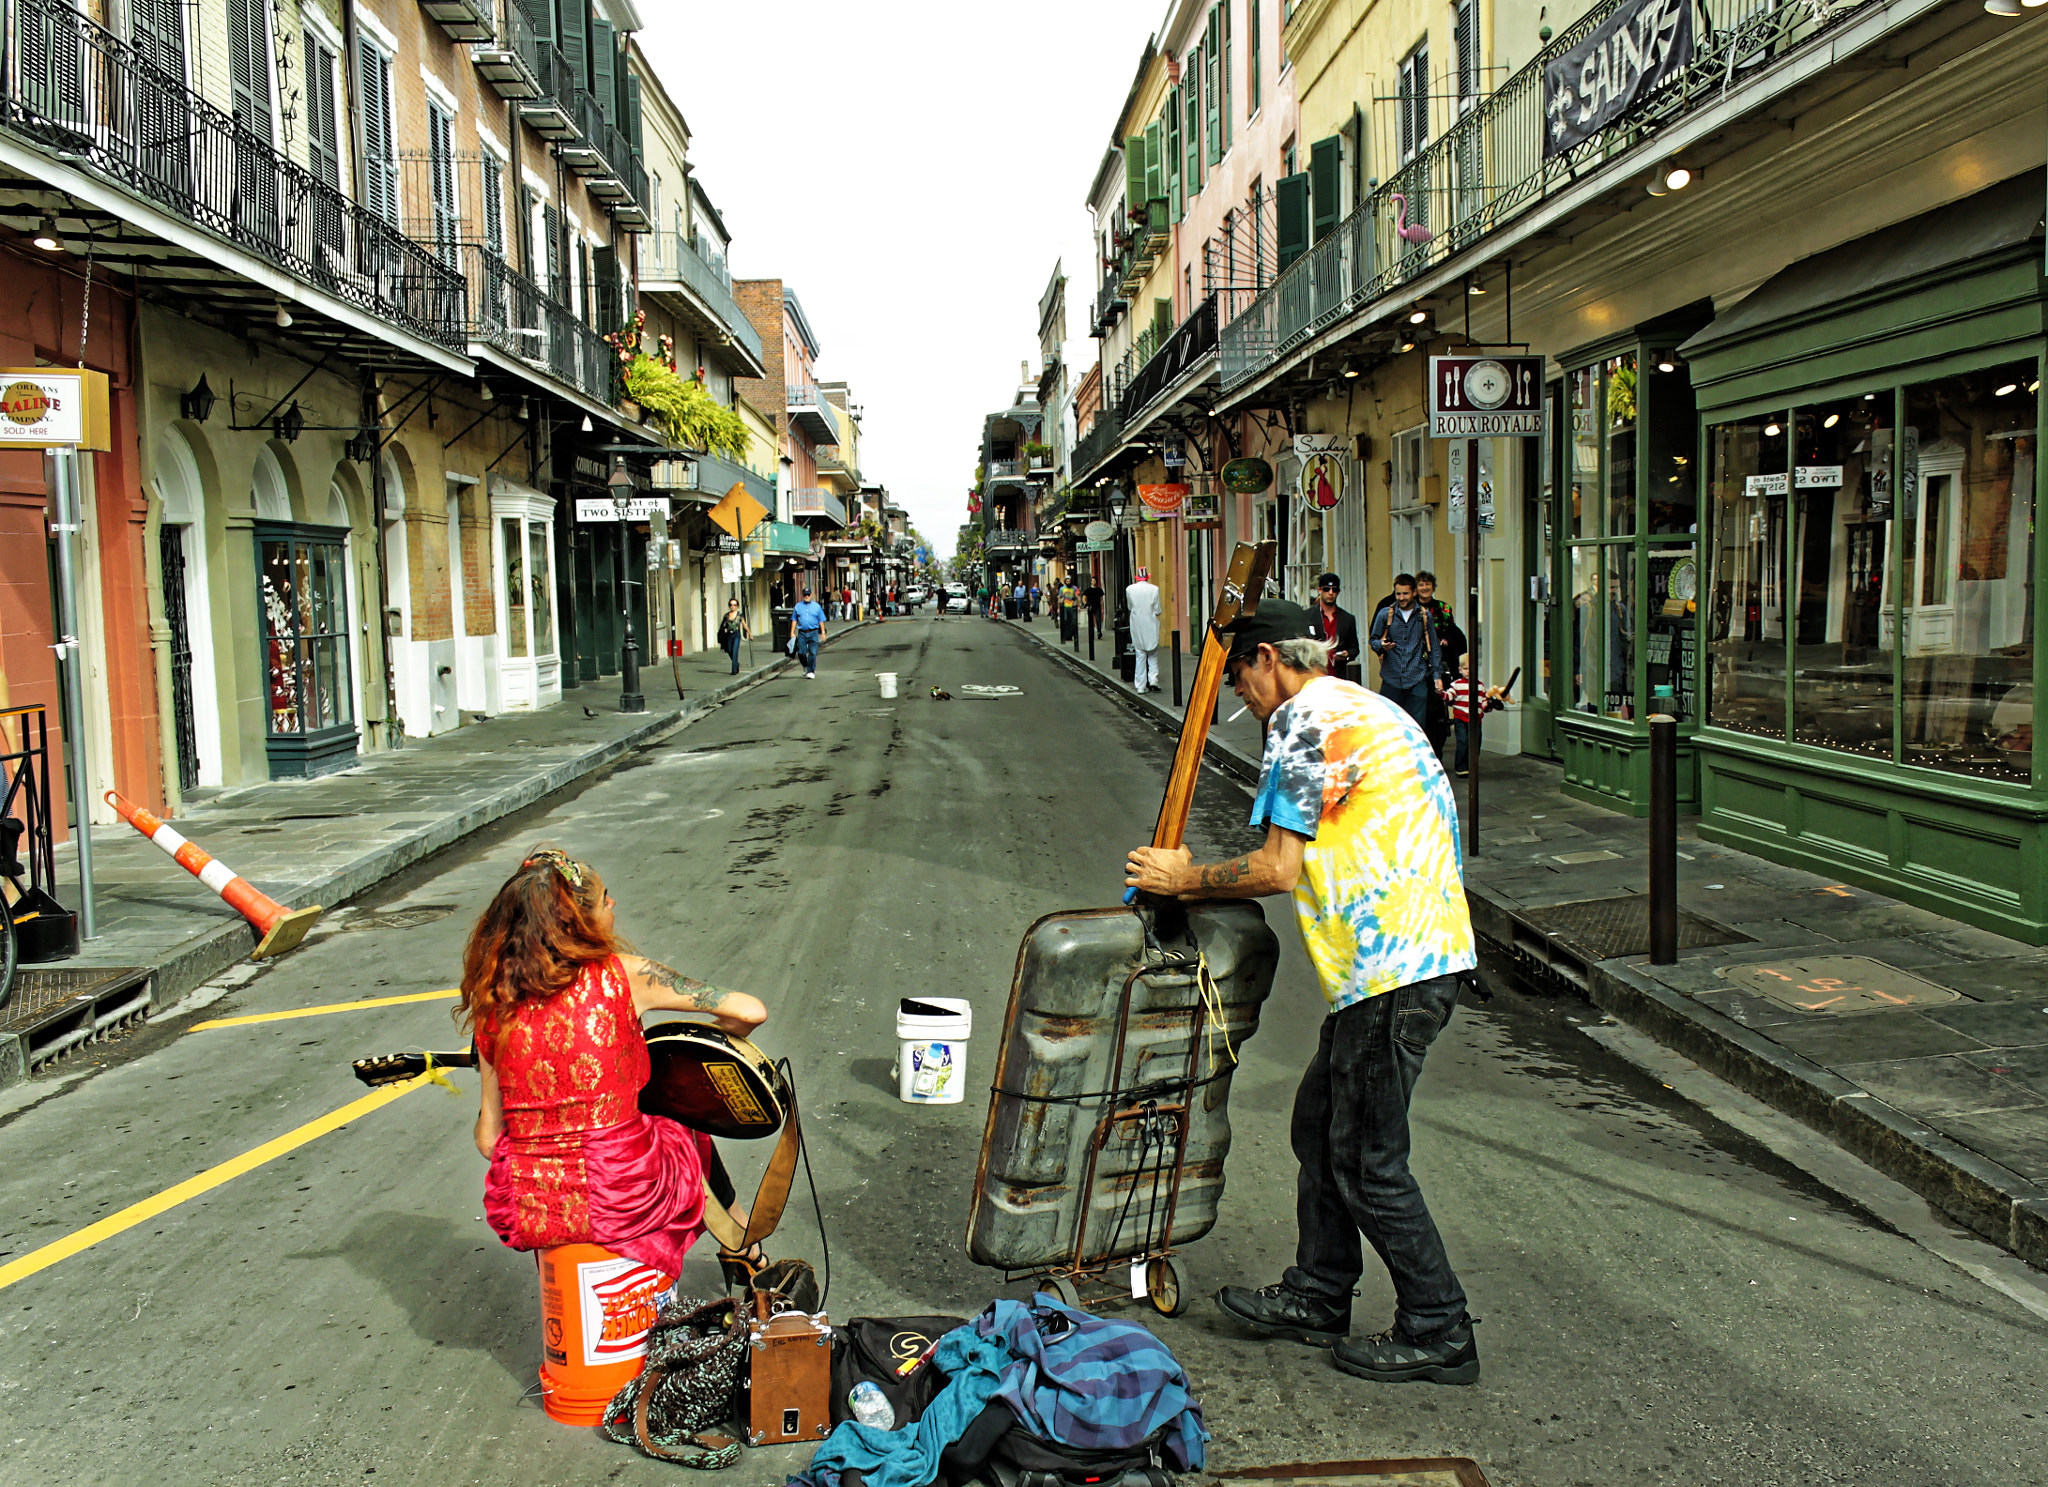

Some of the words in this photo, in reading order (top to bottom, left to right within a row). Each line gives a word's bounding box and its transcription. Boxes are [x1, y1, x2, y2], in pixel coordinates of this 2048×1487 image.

[0, 384, 12, 392] EW
[16, 383, 59, 394] ORLEANS
[0, 396, 62, 414] RALINE
[3, 426, 26, 436] SOLD
[29, 427, 49, 436] HERE
[1436, 416, 1477, 434] ROUX
[1480, 415, 1542, 433] ROYALE
[1295, 434, 1349, 460] Sashay
[581, 508, 609, 517] TWO
[601, 1300, 659, 1342] HOMER
